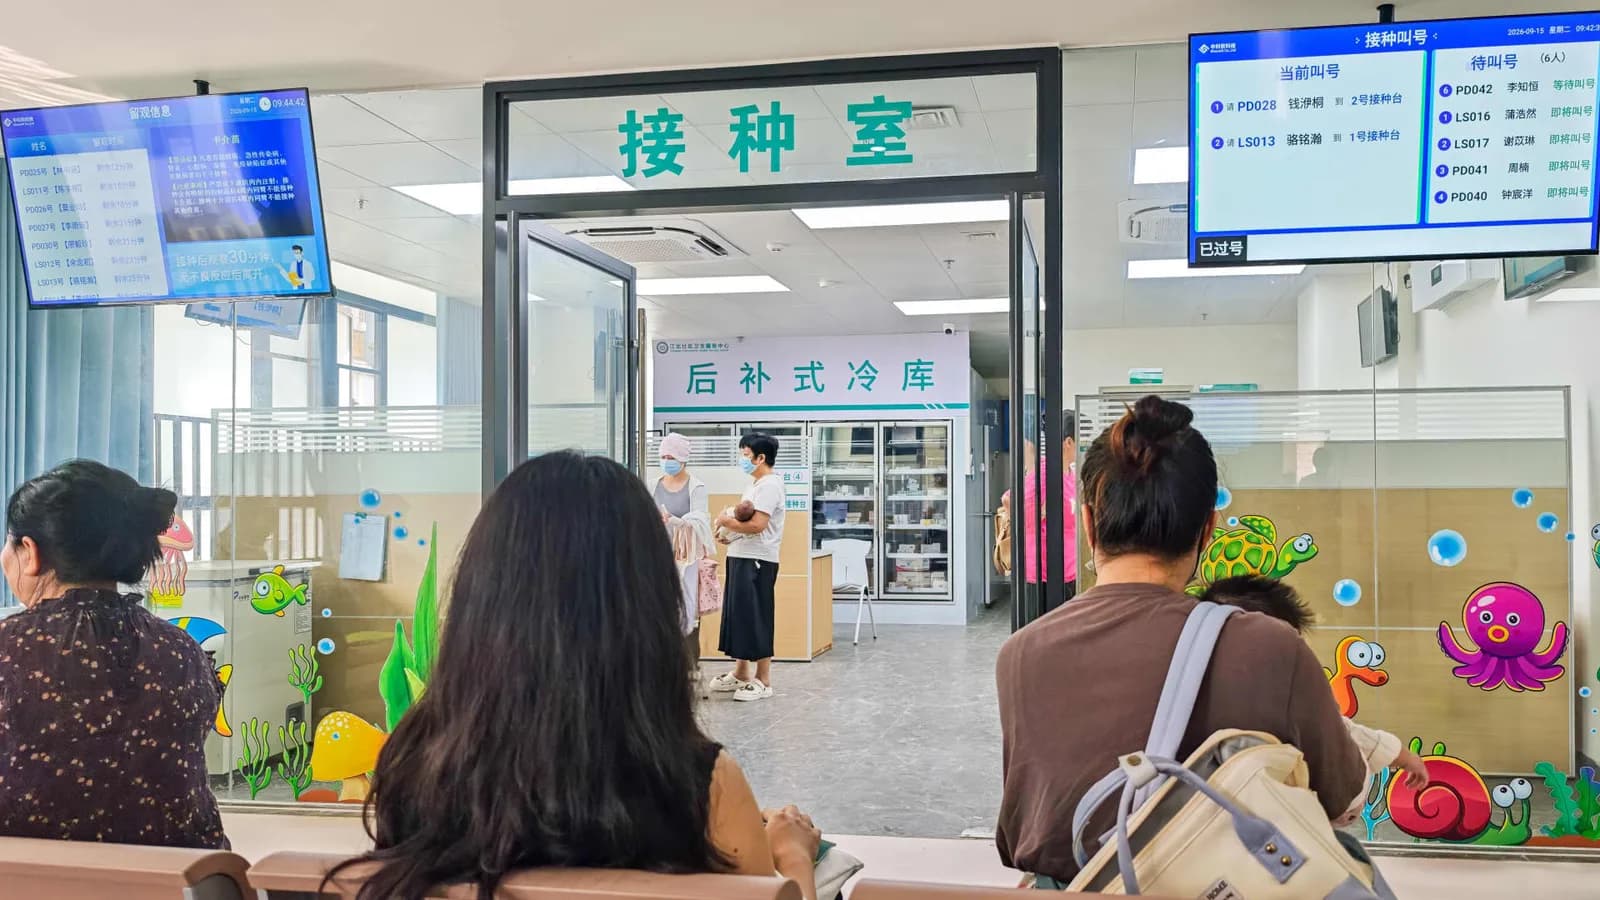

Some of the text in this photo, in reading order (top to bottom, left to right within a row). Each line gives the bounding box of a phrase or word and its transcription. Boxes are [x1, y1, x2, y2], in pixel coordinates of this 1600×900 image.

[1364, 30, 1427, 49] 接种叫号
[1508, 27, 1544, 36] 2026-09-15
[1549, 26, 1571, 34] 星期二
[1471, 52, 1567, 71] 待叫号 （6人）
[1280, 63, 1340, 82] 当前叫号
[1456, 84, 1493, 95] PD042
[1507, 81, 1539, 93] 李知恒
[1553, 78, 1595, 91] 等待叫号
[272, 97, 306, 108] 09:44:42
[1226, 102, 1234, 111] 请
[1238, 100, 1276, 112] PD028
[1335, 97, 1343, 106] 到
[1351, 92, 1403, 106] 2号接种台
[128, 104, 171, 120] 留观信息
[1456, 112, 1490, 123] LS016
[1505, 108, 1537, 120] 蒲浩然
[1551, 105, 1593, 118] 即将叫号
[618, 94, 913, 179] 接种室
[1227, 138, 1234, 147] 请
[1238, 136, 1276, 148] LS013
[1287, 134, 1322, 146] 骆铭瀚
[1333, 133, 1342, 142] 到
[1349, 129, 1400, 142] 1号接种台
[1454, 138, 1489, 149] LS017
[1504, 136, 1535, 147] 谢苡琳
[1549, 133, 1591, 145] 即将叫号
[31, 141, 47, 152] 姓名
[1452, 165, 1488, 176] PD041
[1508, 162, 1530, 174] 周楠
[1549, 160, 1591, 172] 即将叫号
[1451, 191, 1487, 203] PD040
[1502, 188, 1533, 200] 钟宸洋
[1547, 186, 1589, 199] 即将叫号
[1200, 240, 1244, 257] 已过号
[686, 358, 935, 395] 后补式冷库
